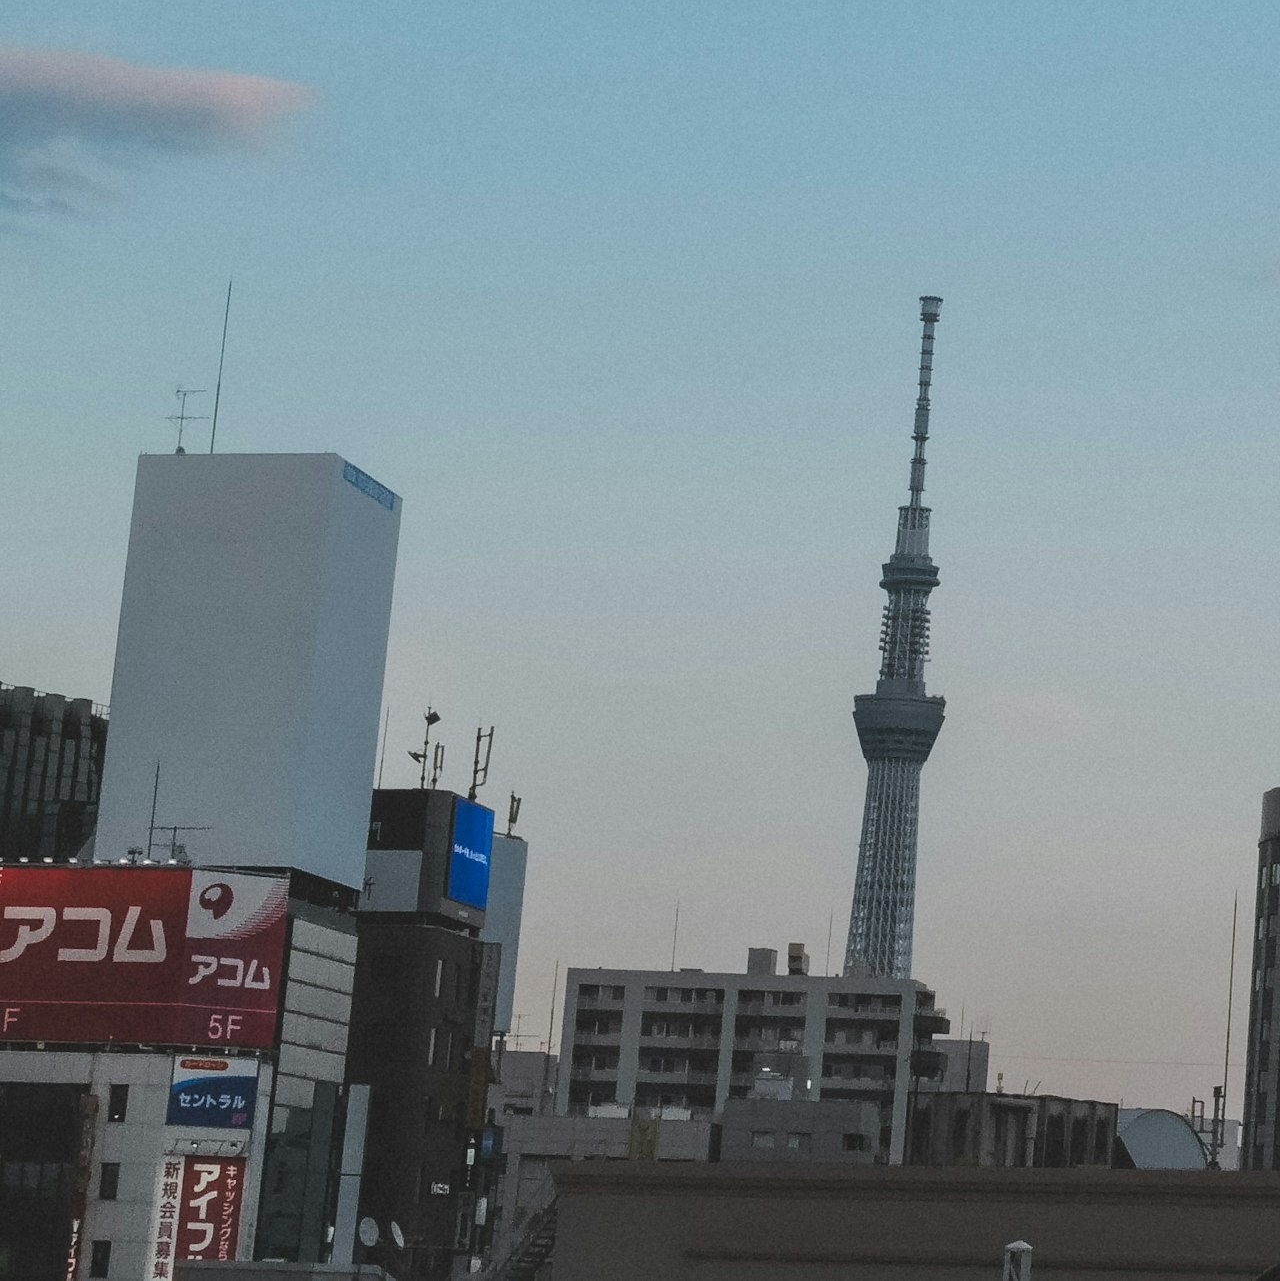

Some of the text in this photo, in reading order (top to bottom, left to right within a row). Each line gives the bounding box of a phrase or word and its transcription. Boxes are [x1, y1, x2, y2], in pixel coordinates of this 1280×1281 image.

[0, 906, 167, 963] アコム
[188, 956, 271, 990] アコム
[207, 1015, 243, 1040] 5F
[179, 1092, 246, 1109] セントラル
[152, 1162, 181, 1281] 新規会員募集
[187, 1163, 221, 1260] アイフ
